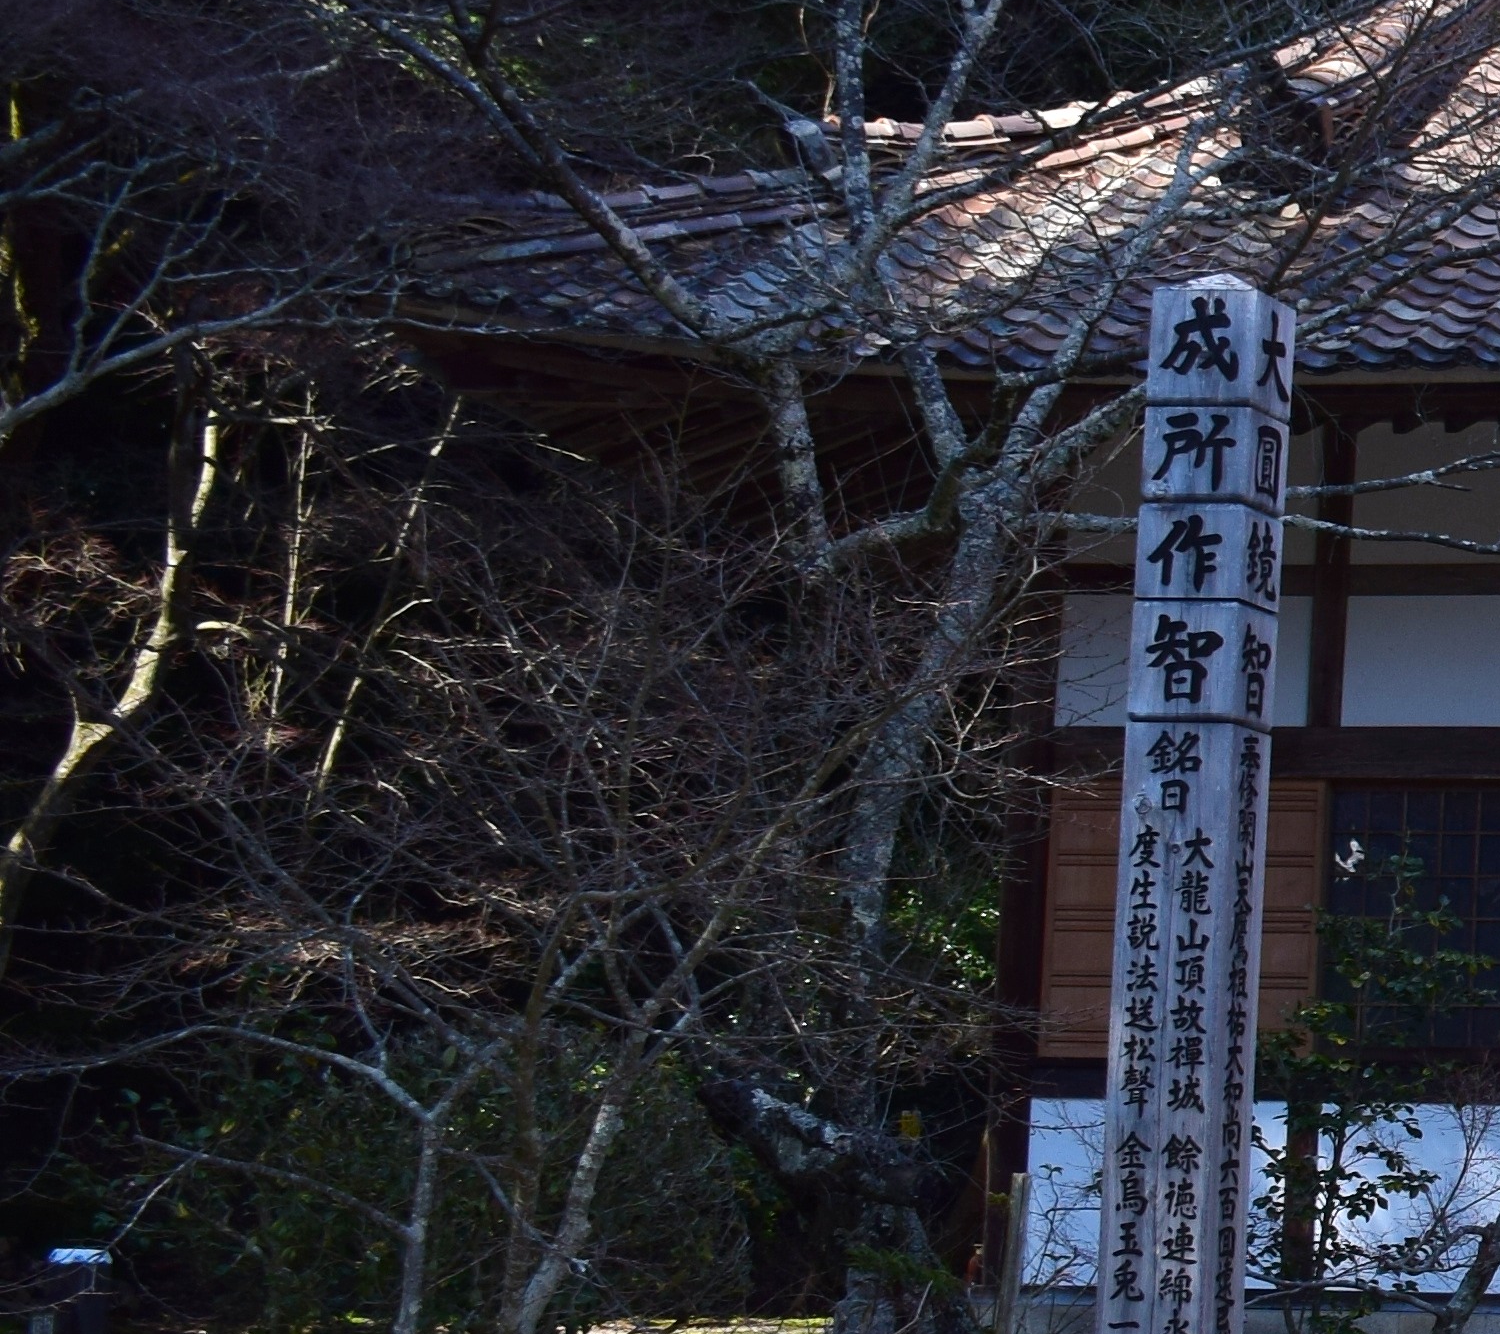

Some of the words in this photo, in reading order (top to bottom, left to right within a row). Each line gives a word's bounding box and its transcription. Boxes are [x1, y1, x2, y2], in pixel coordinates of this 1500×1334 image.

[1146, 296, 1239, 704] 成所作智
[1242, 310, 1289, 717] 大圓鏡智
